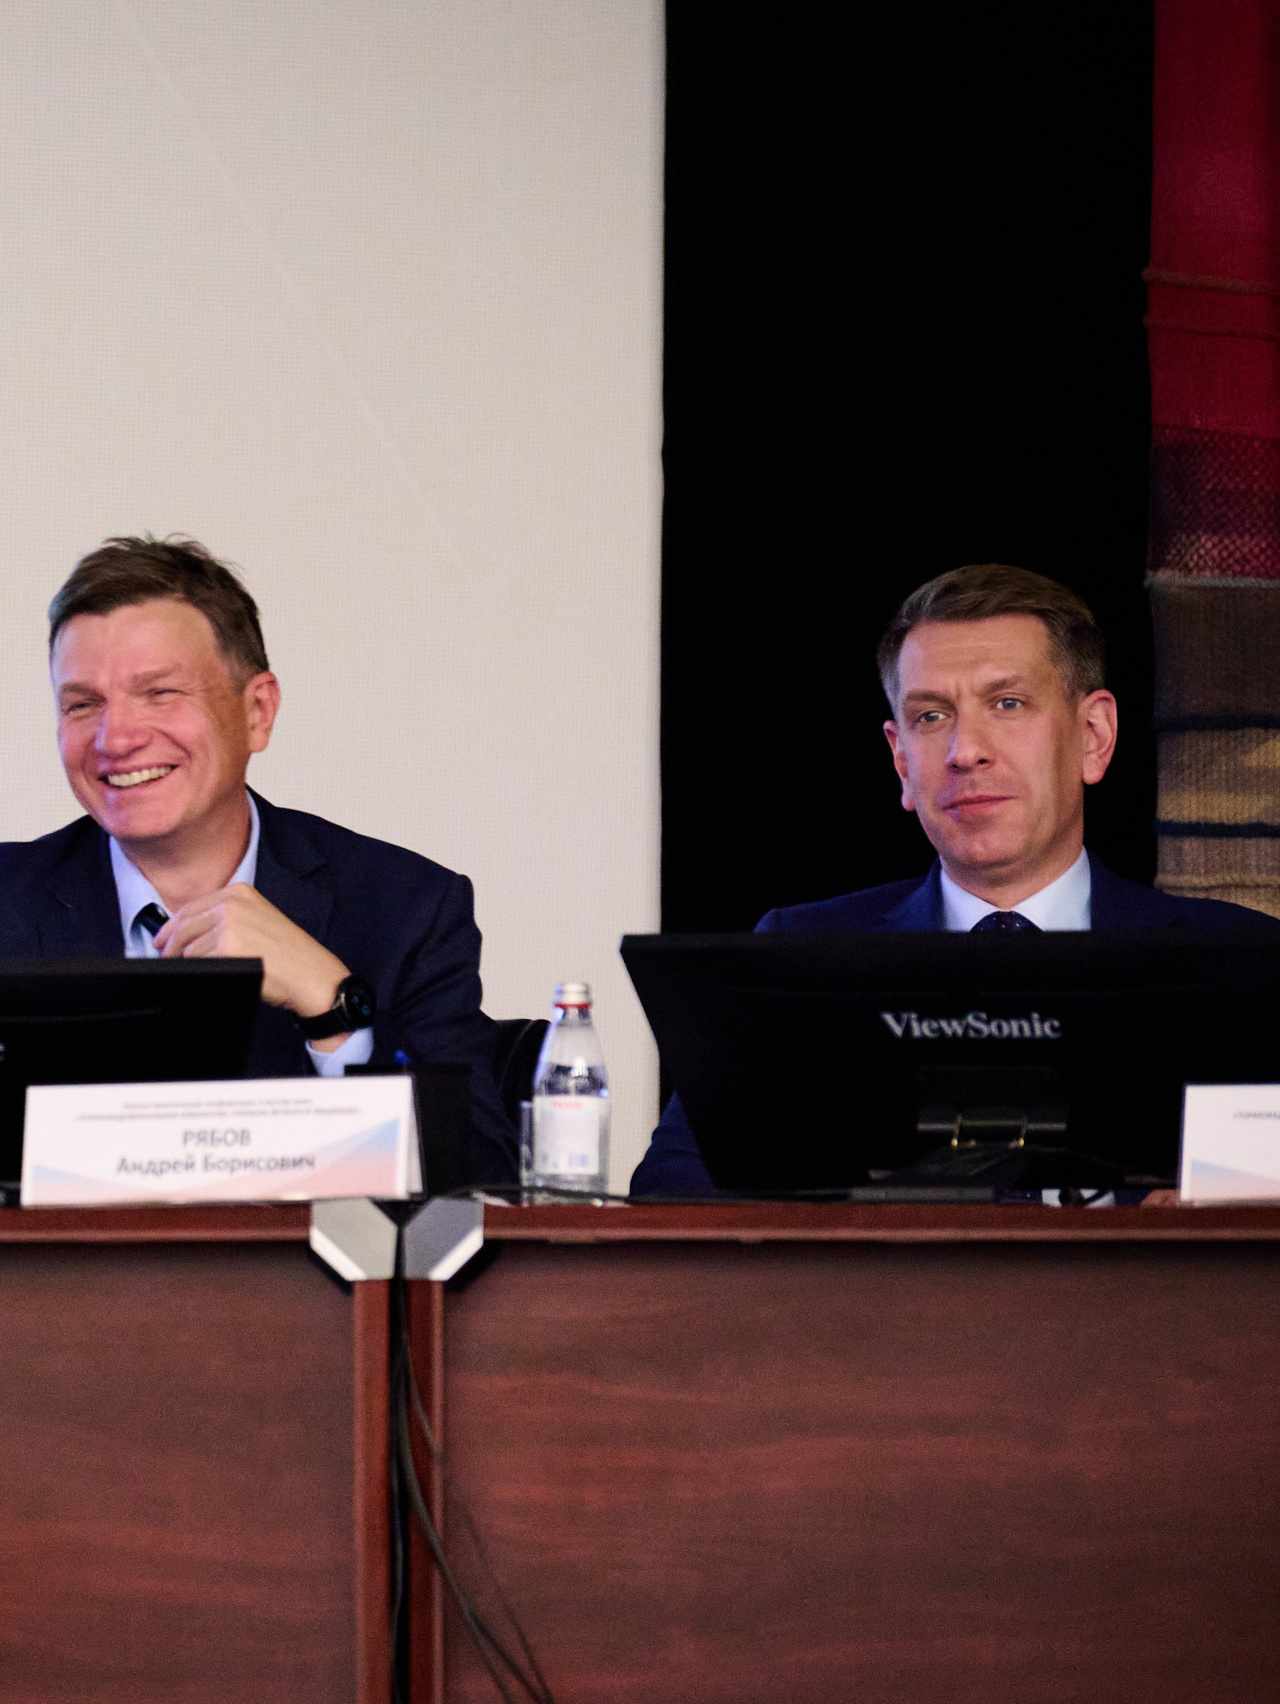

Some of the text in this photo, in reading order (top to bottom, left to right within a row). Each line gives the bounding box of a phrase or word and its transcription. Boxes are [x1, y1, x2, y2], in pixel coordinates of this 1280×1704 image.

[881, 1011, 1063, 1038] ViewSonic
[182, 1129, 252, 1147] РЯБОВ
[117, 1154, 316, 1176] Андрей Борисович
